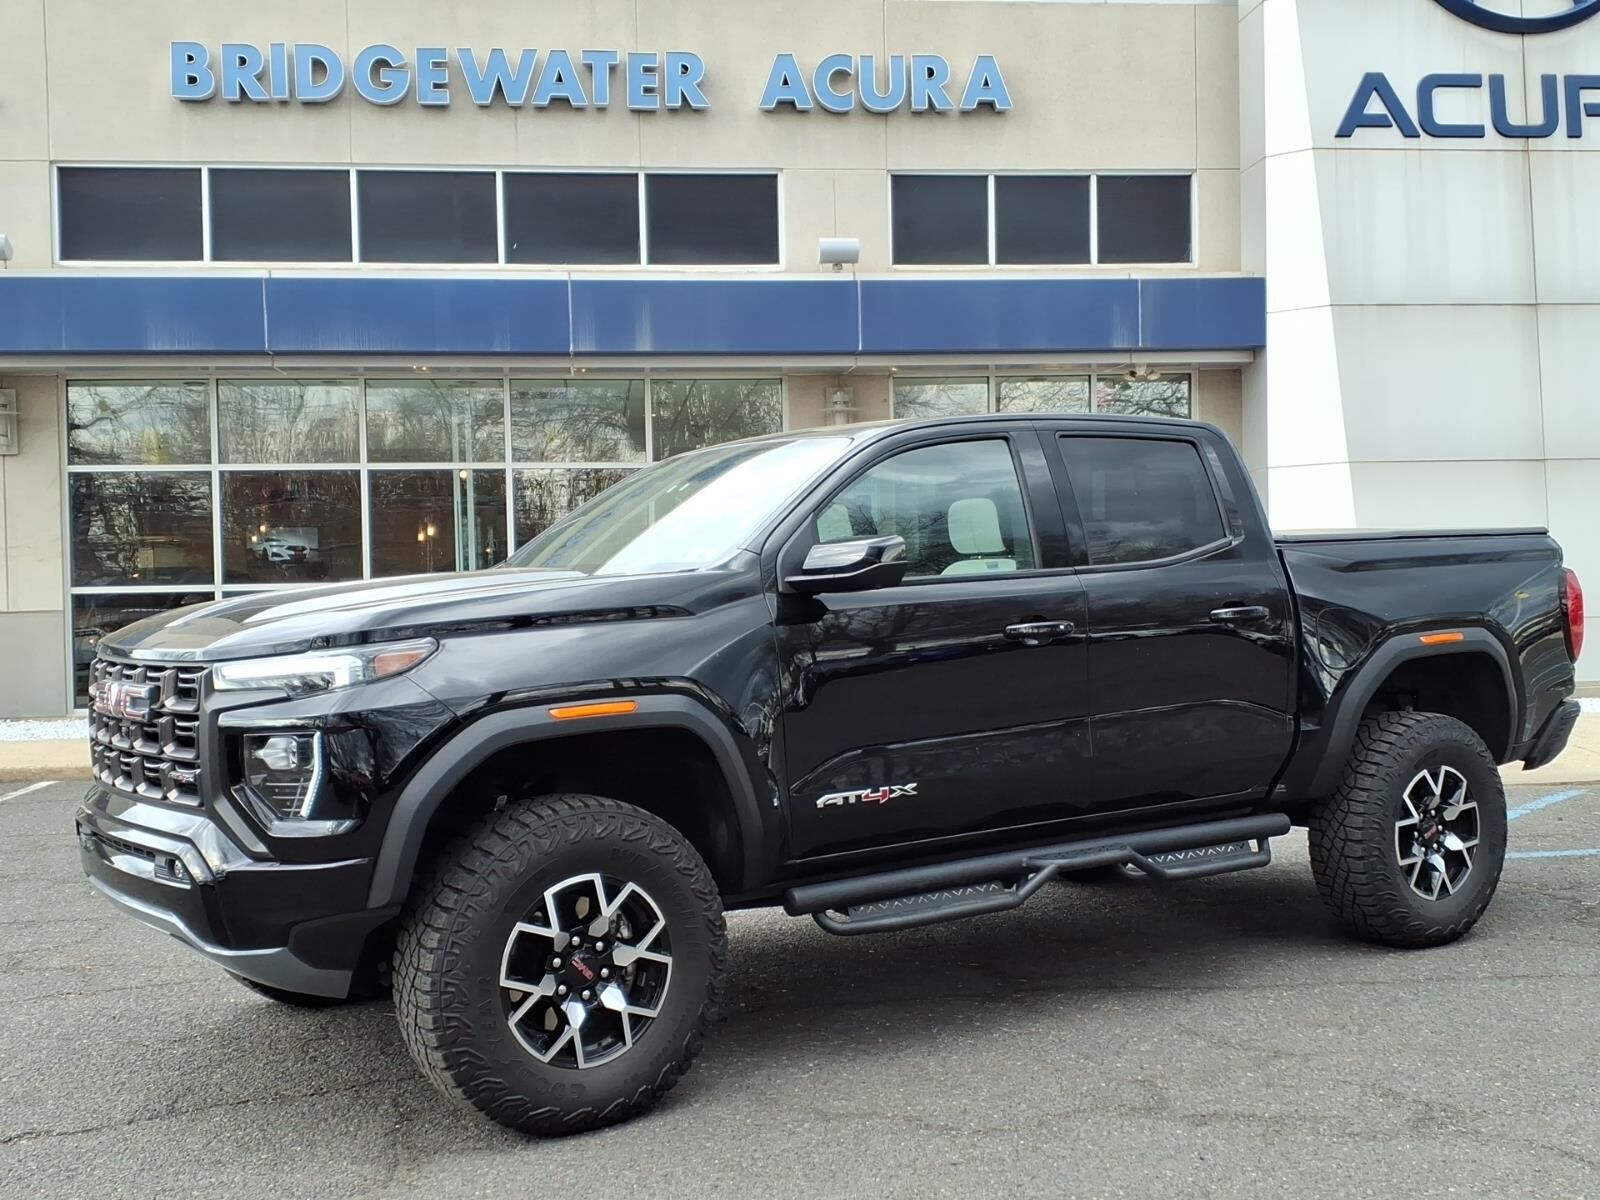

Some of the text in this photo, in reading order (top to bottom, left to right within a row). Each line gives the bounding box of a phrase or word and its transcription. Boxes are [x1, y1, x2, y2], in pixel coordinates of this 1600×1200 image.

[170, 41, 1013, 112] BRIDGEWATER ACURA
[94, 681, 157, 722] GMC
[816, 783, 918, 808] AT4X
